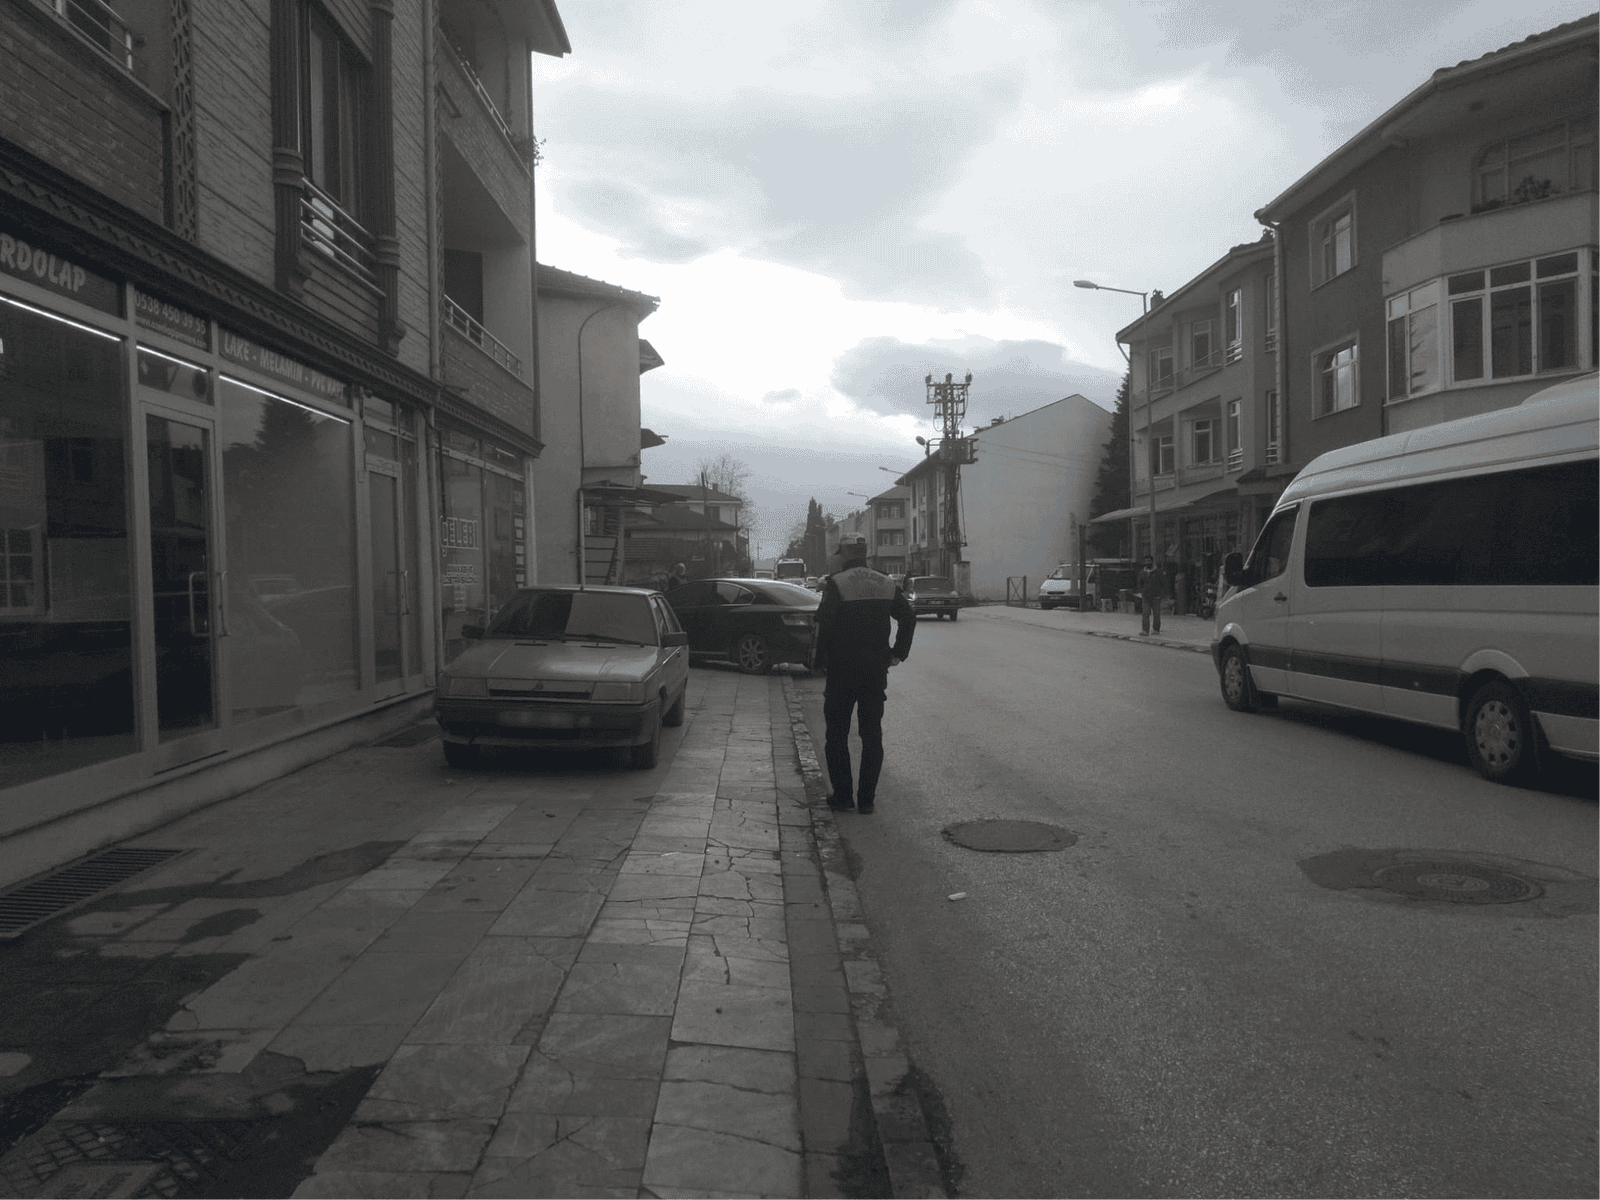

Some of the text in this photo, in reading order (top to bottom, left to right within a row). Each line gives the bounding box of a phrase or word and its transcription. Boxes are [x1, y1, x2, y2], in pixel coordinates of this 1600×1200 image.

[0, 233, 86, 292] RDOLAP
[135, 291, 160, 315] 0538
[162, 304, 180, 324] 450
[182, 311, 193, 329] 39
[195, 317, 206, 334] 55
[224, 332, 249, 361] LAKE
